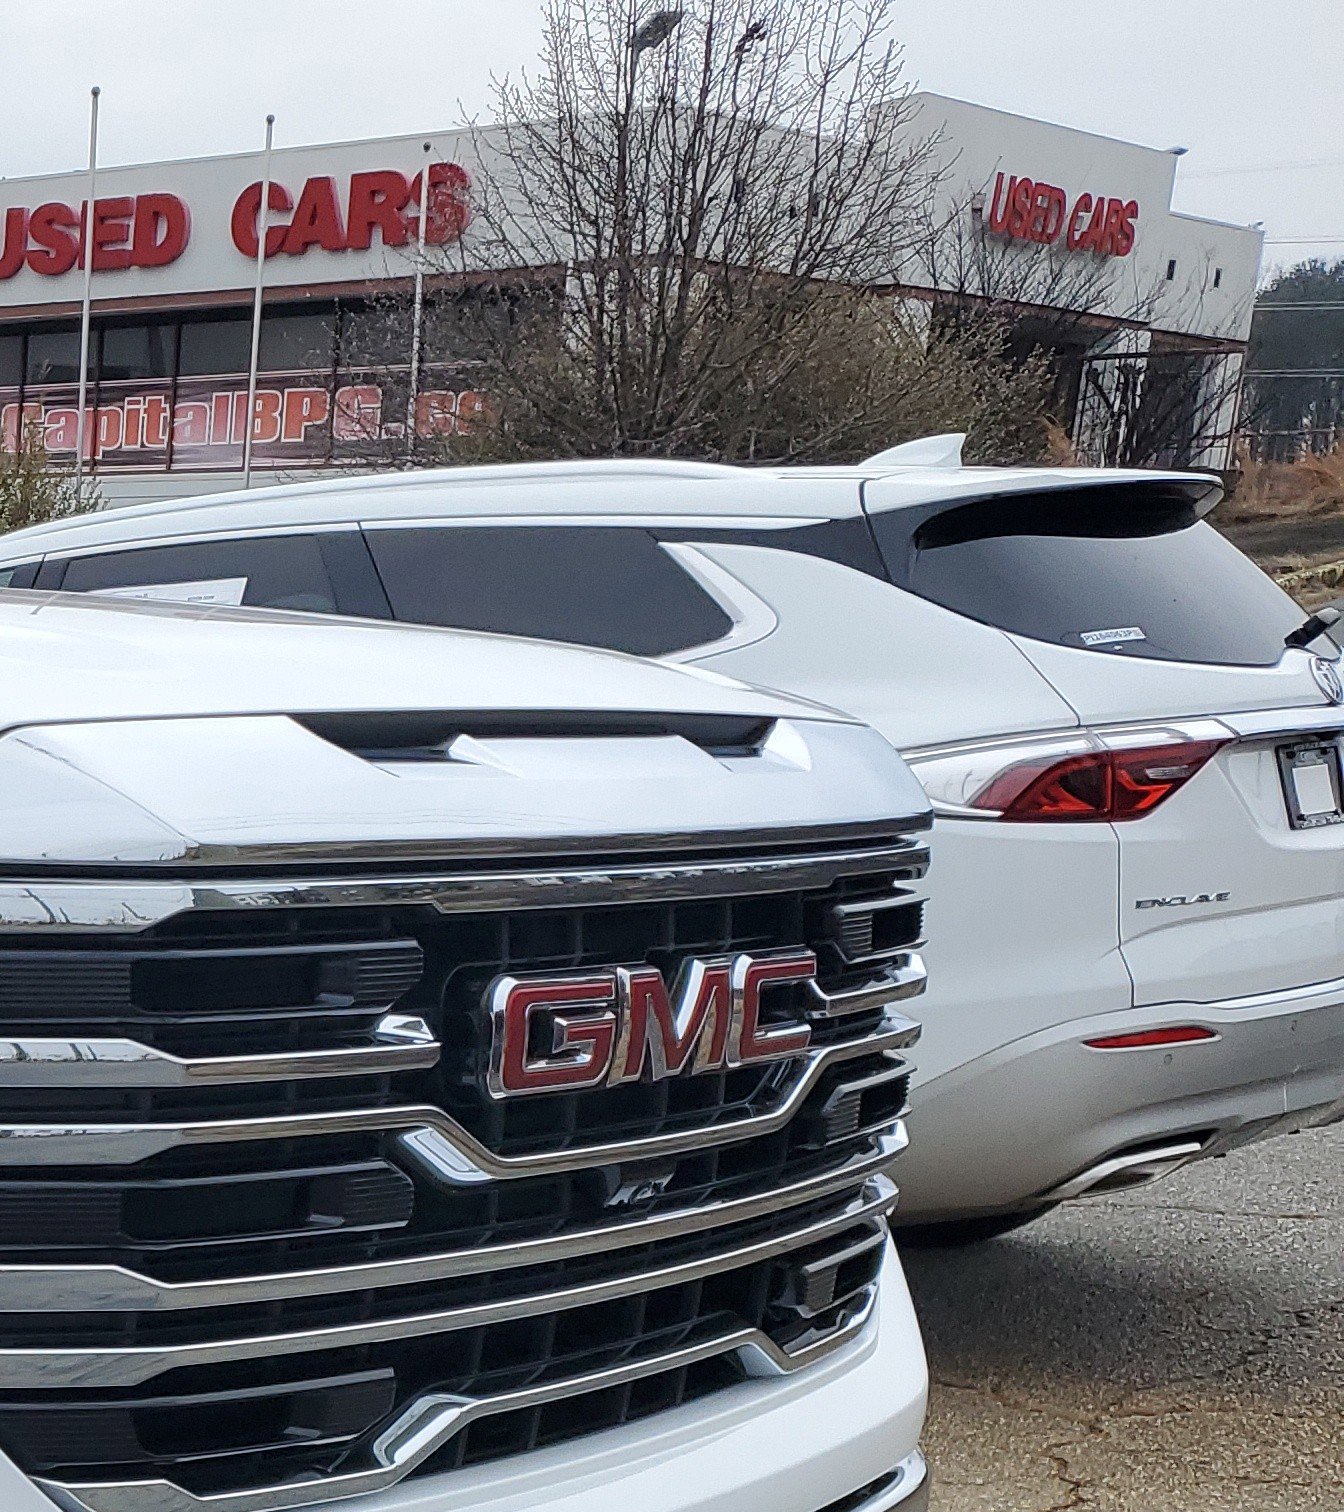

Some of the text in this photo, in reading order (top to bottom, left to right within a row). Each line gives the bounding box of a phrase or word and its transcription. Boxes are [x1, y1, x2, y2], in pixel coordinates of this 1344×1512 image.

[231, 161, 474, 259] CARS
[989, 171, 1139, 258] USED CARS
[486, 948, 817, 1100] GMC
